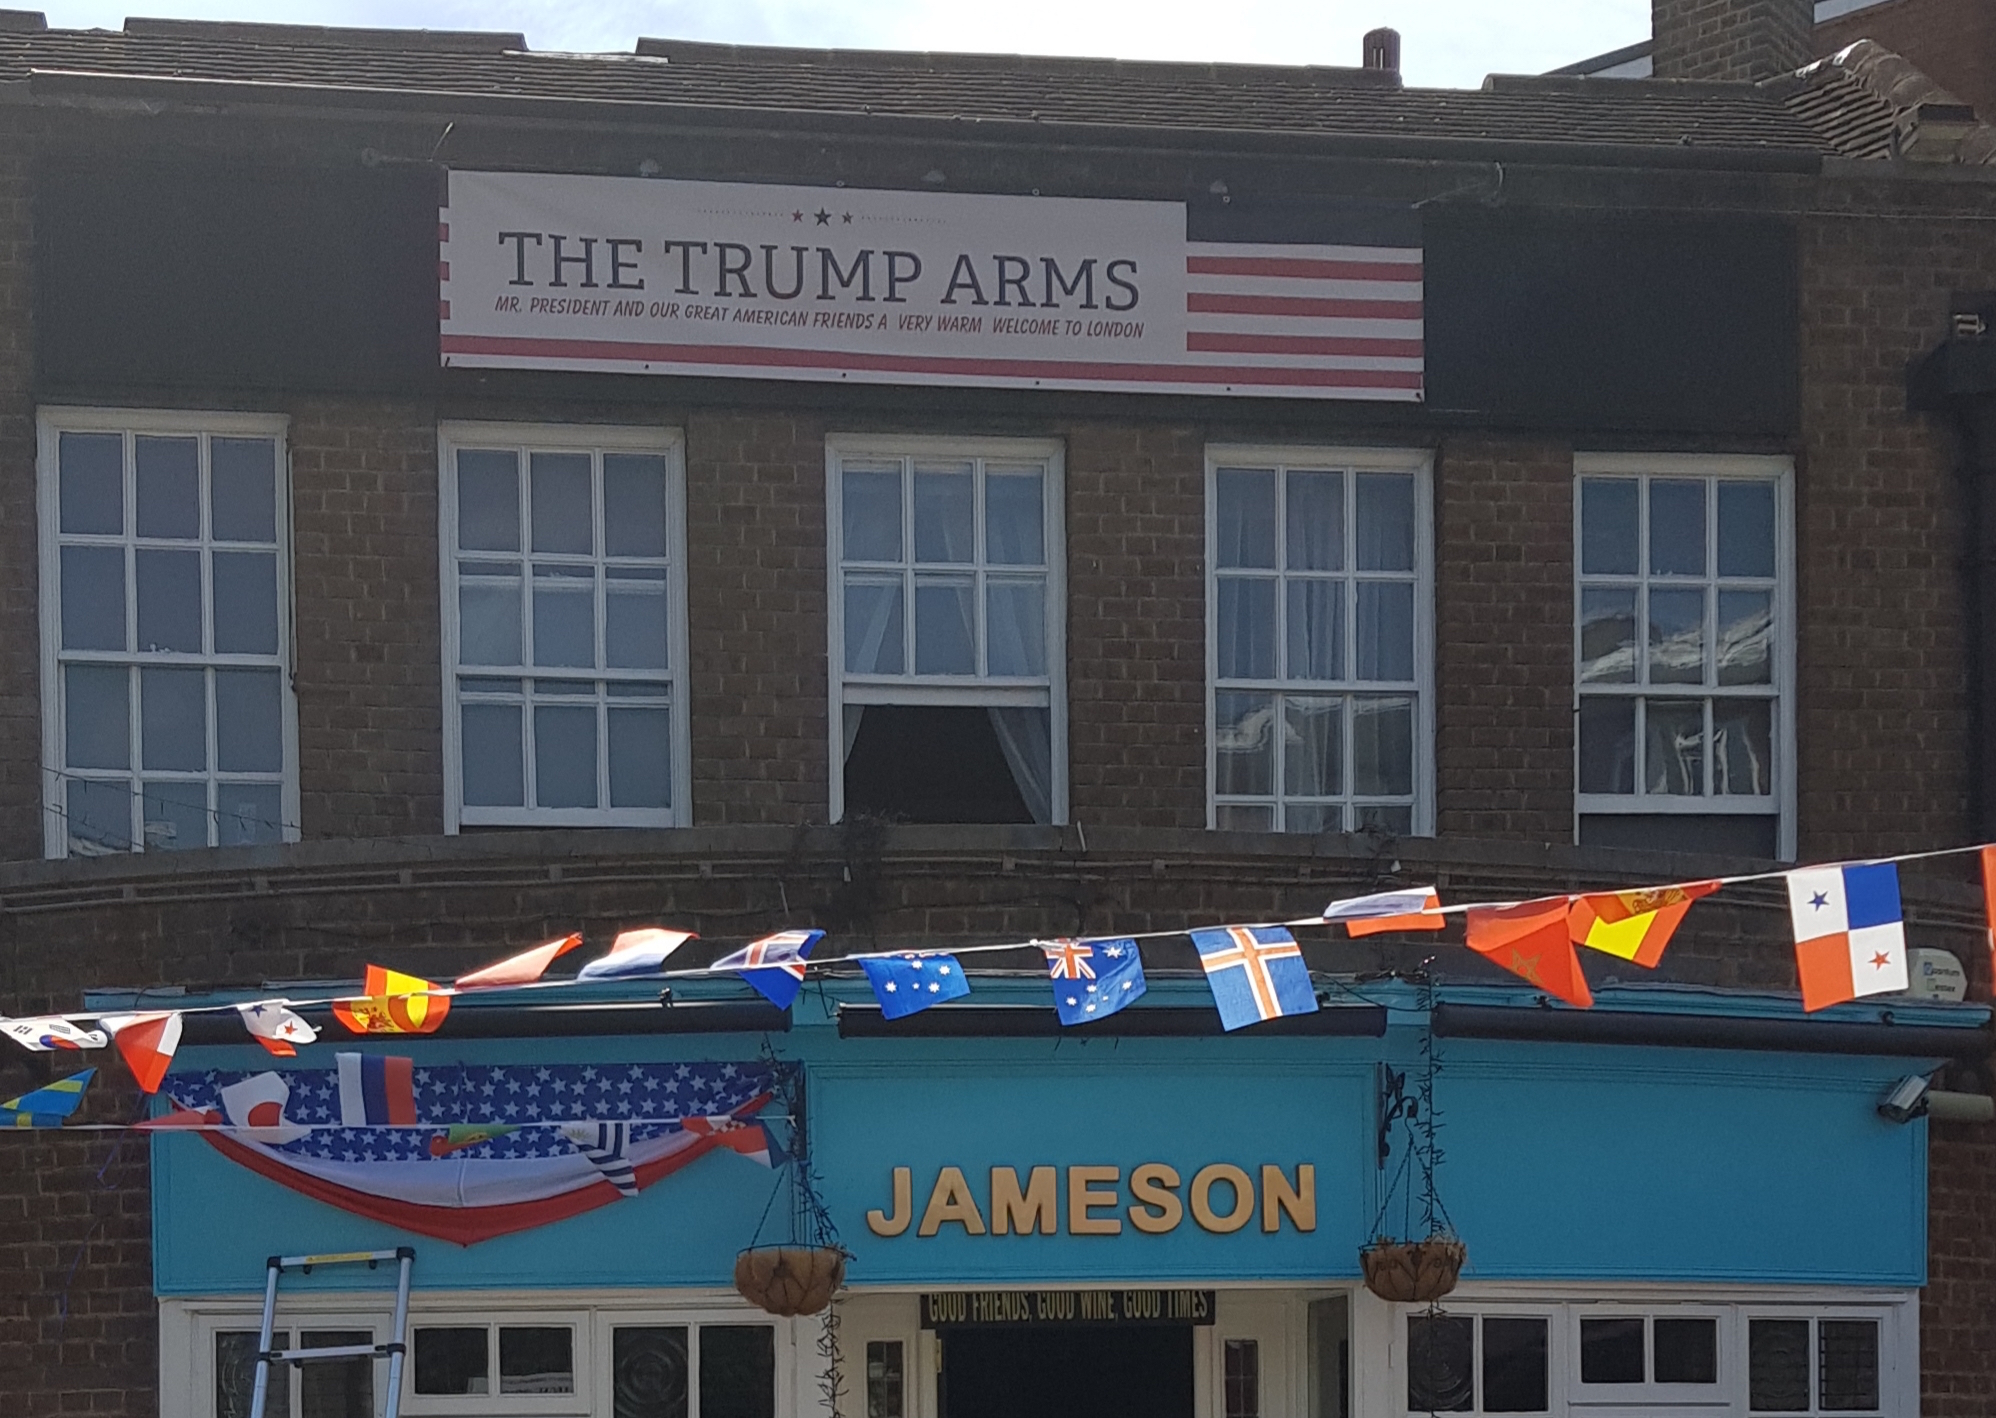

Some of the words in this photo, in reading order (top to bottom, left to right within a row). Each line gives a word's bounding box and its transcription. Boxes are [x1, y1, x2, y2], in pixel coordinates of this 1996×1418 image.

[498, 231, 645, 290] THE
[664, 239, 922, 302] TRUMP
[940, 253, 1139, 311] ARMS
[494, 296, 522, 313] MR.
[530, 297, 611, 316] PRESIDENT
[613, 299, 645, 318] AND
[650, 301, 679, 319] OUR
[684, 303, 730, 322] GREAT
[733, 306, 808, 327] AMERICAN
[813, 310, 874, 330] FRIENDS
[878, 313, 888, 330] A
[899, 313, 933, 332] VERY
[937, 315, 982, 333] WARM
[992, 317, 1060, 335] WELCOME
[1065, 319, 1083, 336] TO
[1086, 320, 1145, 339] LONDON
[866, 1162, 1317, 1237] JAMESON
[929, 1292, 967, 1323] GOOD
[972, 1292, 1032, 1323] FRIENDS,
[1037, 1291, 1075, 1321] GOOD
[1080, 1291, 1119, 1322] WINE,
[1123, 1290, 1161, 1319] GOOD
[1167, 1290, 1208, 1319] TIMES
